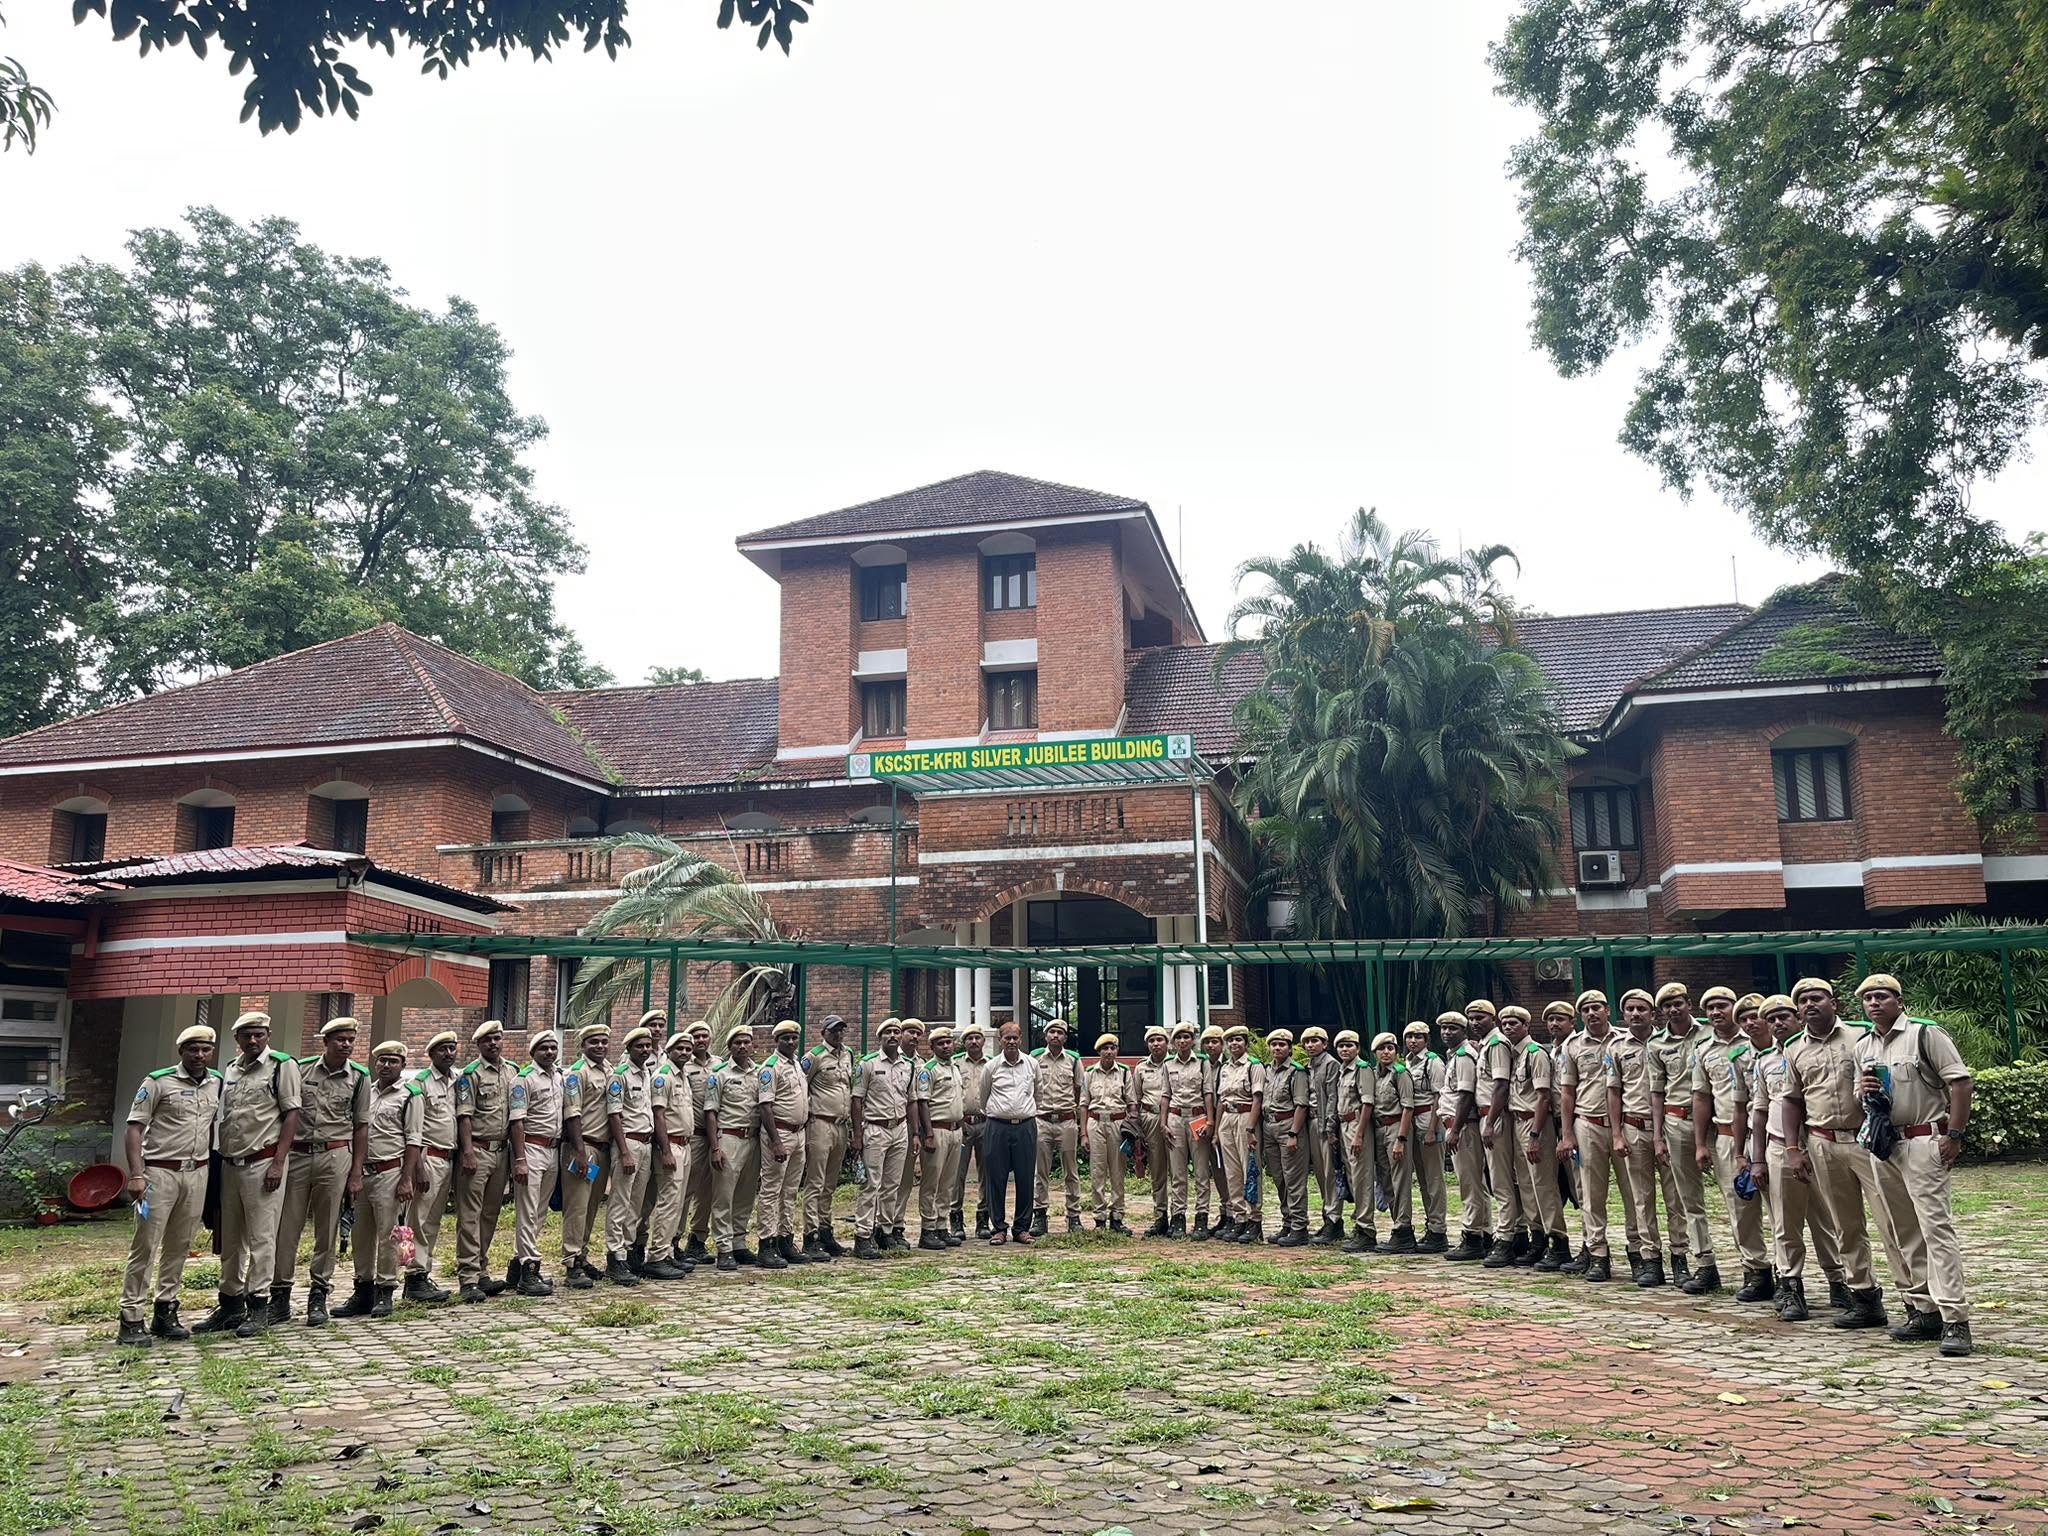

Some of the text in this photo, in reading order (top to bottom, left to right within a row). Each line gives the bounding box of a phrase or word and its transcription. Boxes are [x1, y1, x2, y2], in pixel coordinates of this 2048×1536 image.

[875, 739, 1163, 773] KSCSTE-KFRI SILVER JUBILEE BUILDING
